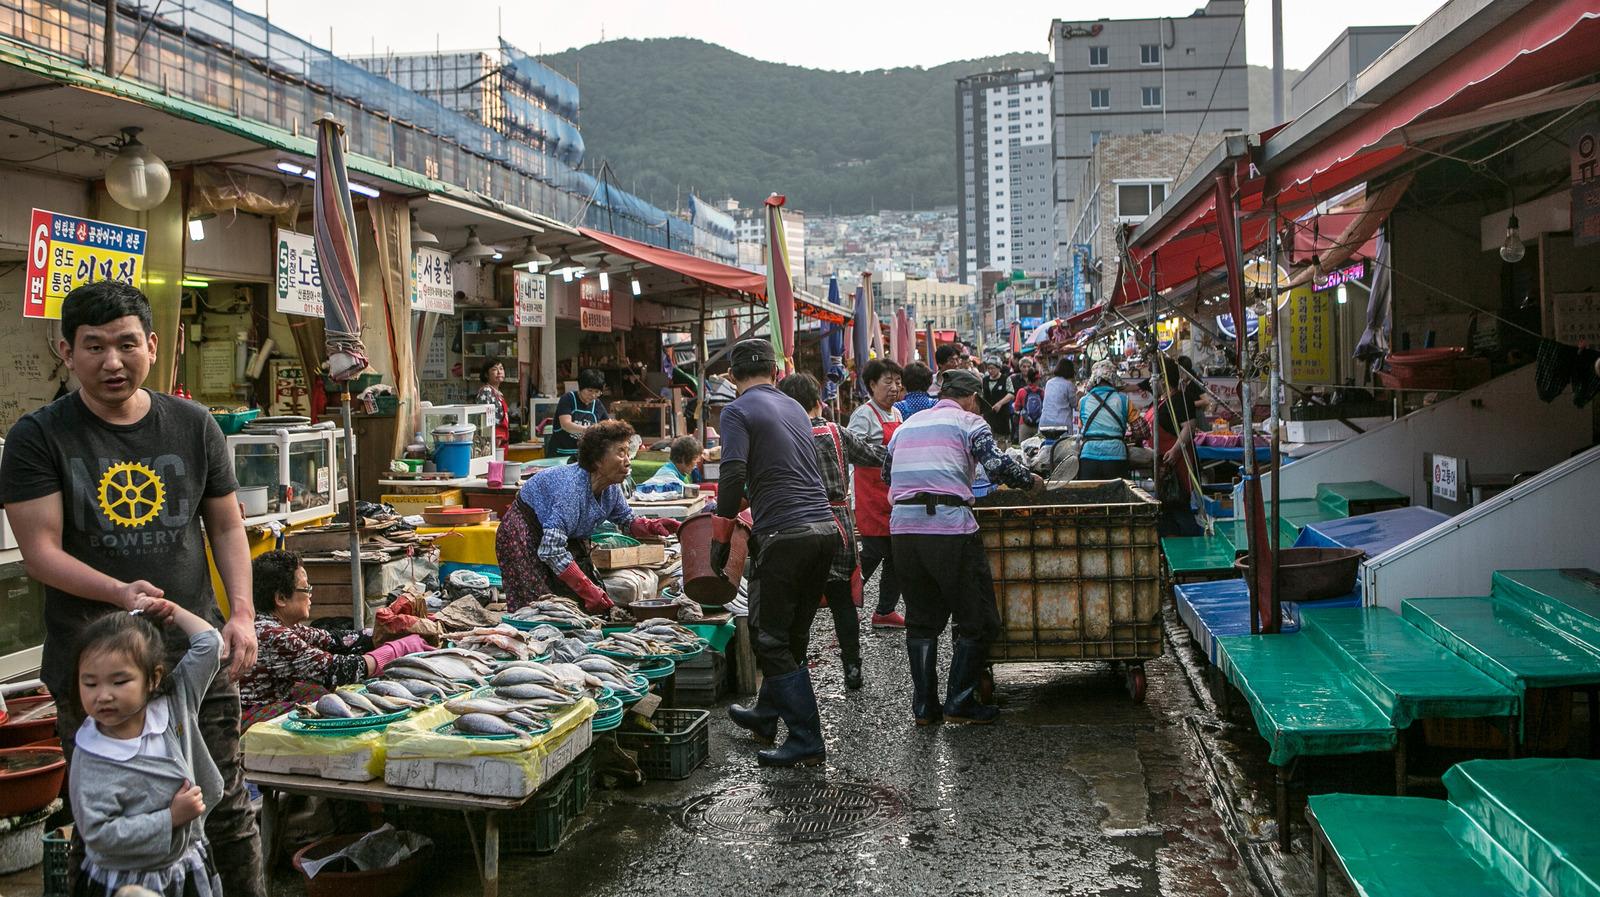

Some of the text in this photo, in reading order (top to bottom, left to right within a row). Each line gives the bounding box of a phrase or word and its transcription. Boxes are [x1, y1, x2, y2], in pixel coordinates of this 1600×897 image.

[54, 219, 76, 239] 연탄불
[76, 222, 87, 241] 산
[126, 232, 141, 250] 전문
[31, 223, 49, 305] 6번
[54, 247, 74, 267] 영도
[424, 254, 452, 285] 서울집
[52, 272, 73, 293] 통영
[1441, 469, 1456, 486] 고등어
[90, 529, 180, 547] BOWERY
